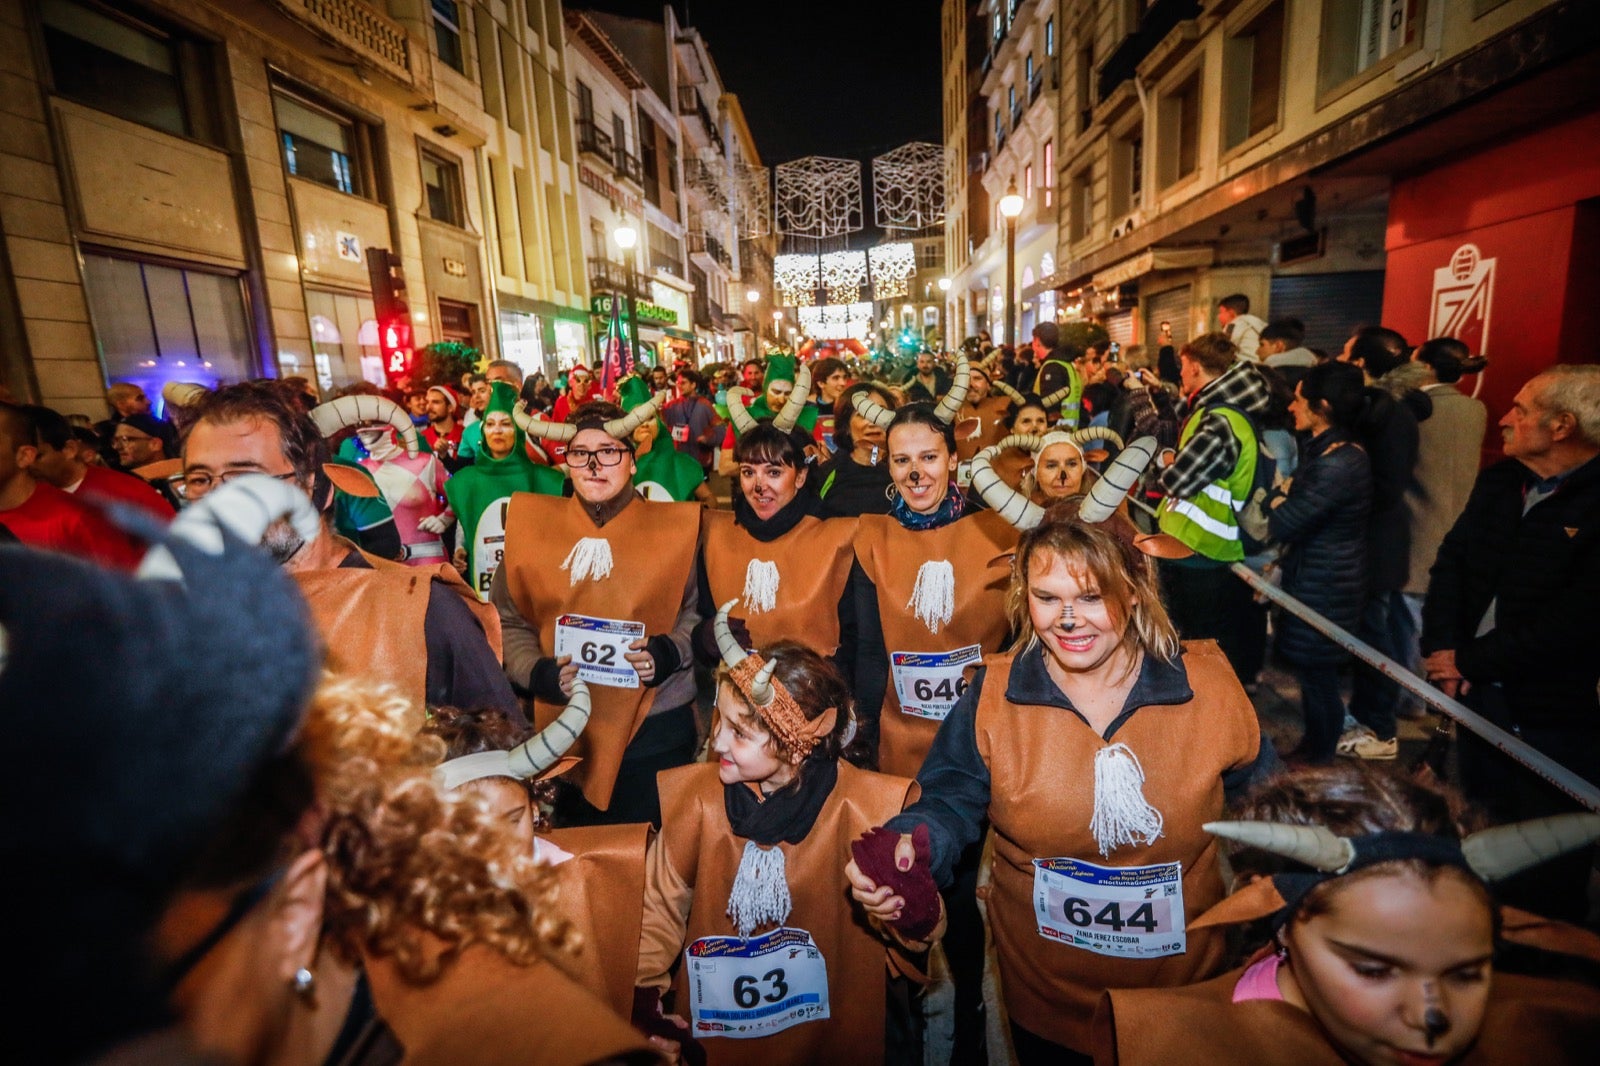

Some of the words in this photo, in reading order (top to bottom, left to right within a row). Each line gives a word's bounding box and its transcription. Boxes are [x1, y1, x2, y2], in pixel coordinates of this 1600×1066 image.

[580, 641, 617, 667] 62
[1098, 875, 1178, 886] #NocturnaGranada2022
[1063, 897, 1158, 933] 644
[1093, 932, 1111, 942] JEREZ
[1112, 933, 1140, 944] ESCOBAR
[733, 968, 789, 1009] 63
